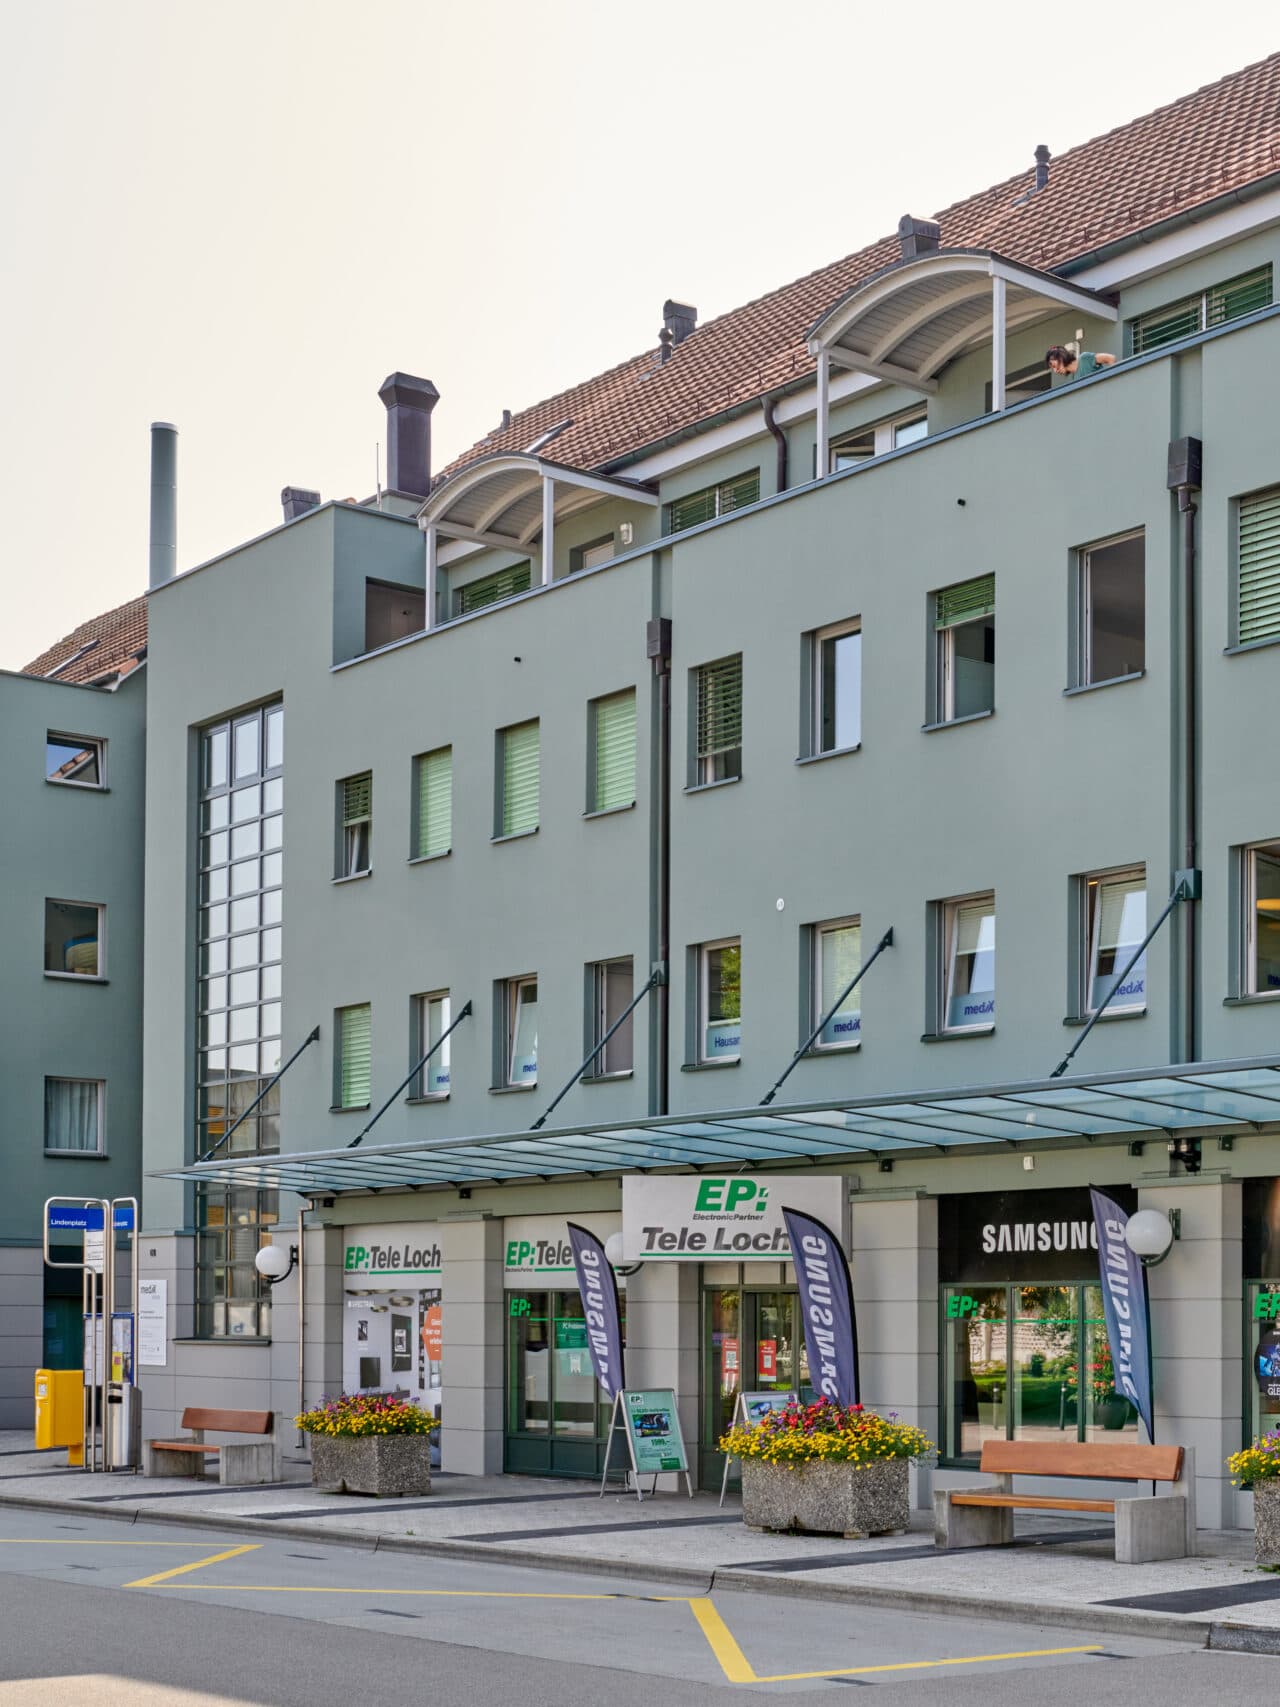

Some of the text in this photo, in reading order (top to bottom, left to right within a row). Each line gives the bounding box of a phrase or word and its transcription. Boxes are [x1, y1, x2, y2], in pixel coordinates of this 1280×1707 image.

[642, 1227, 790, 1250] Tele Loch
[403, 1243, 441, 1268] Loch
[510, 1298, 531, 1317] EP:
[946, 1296, 979, 1317] EP:
